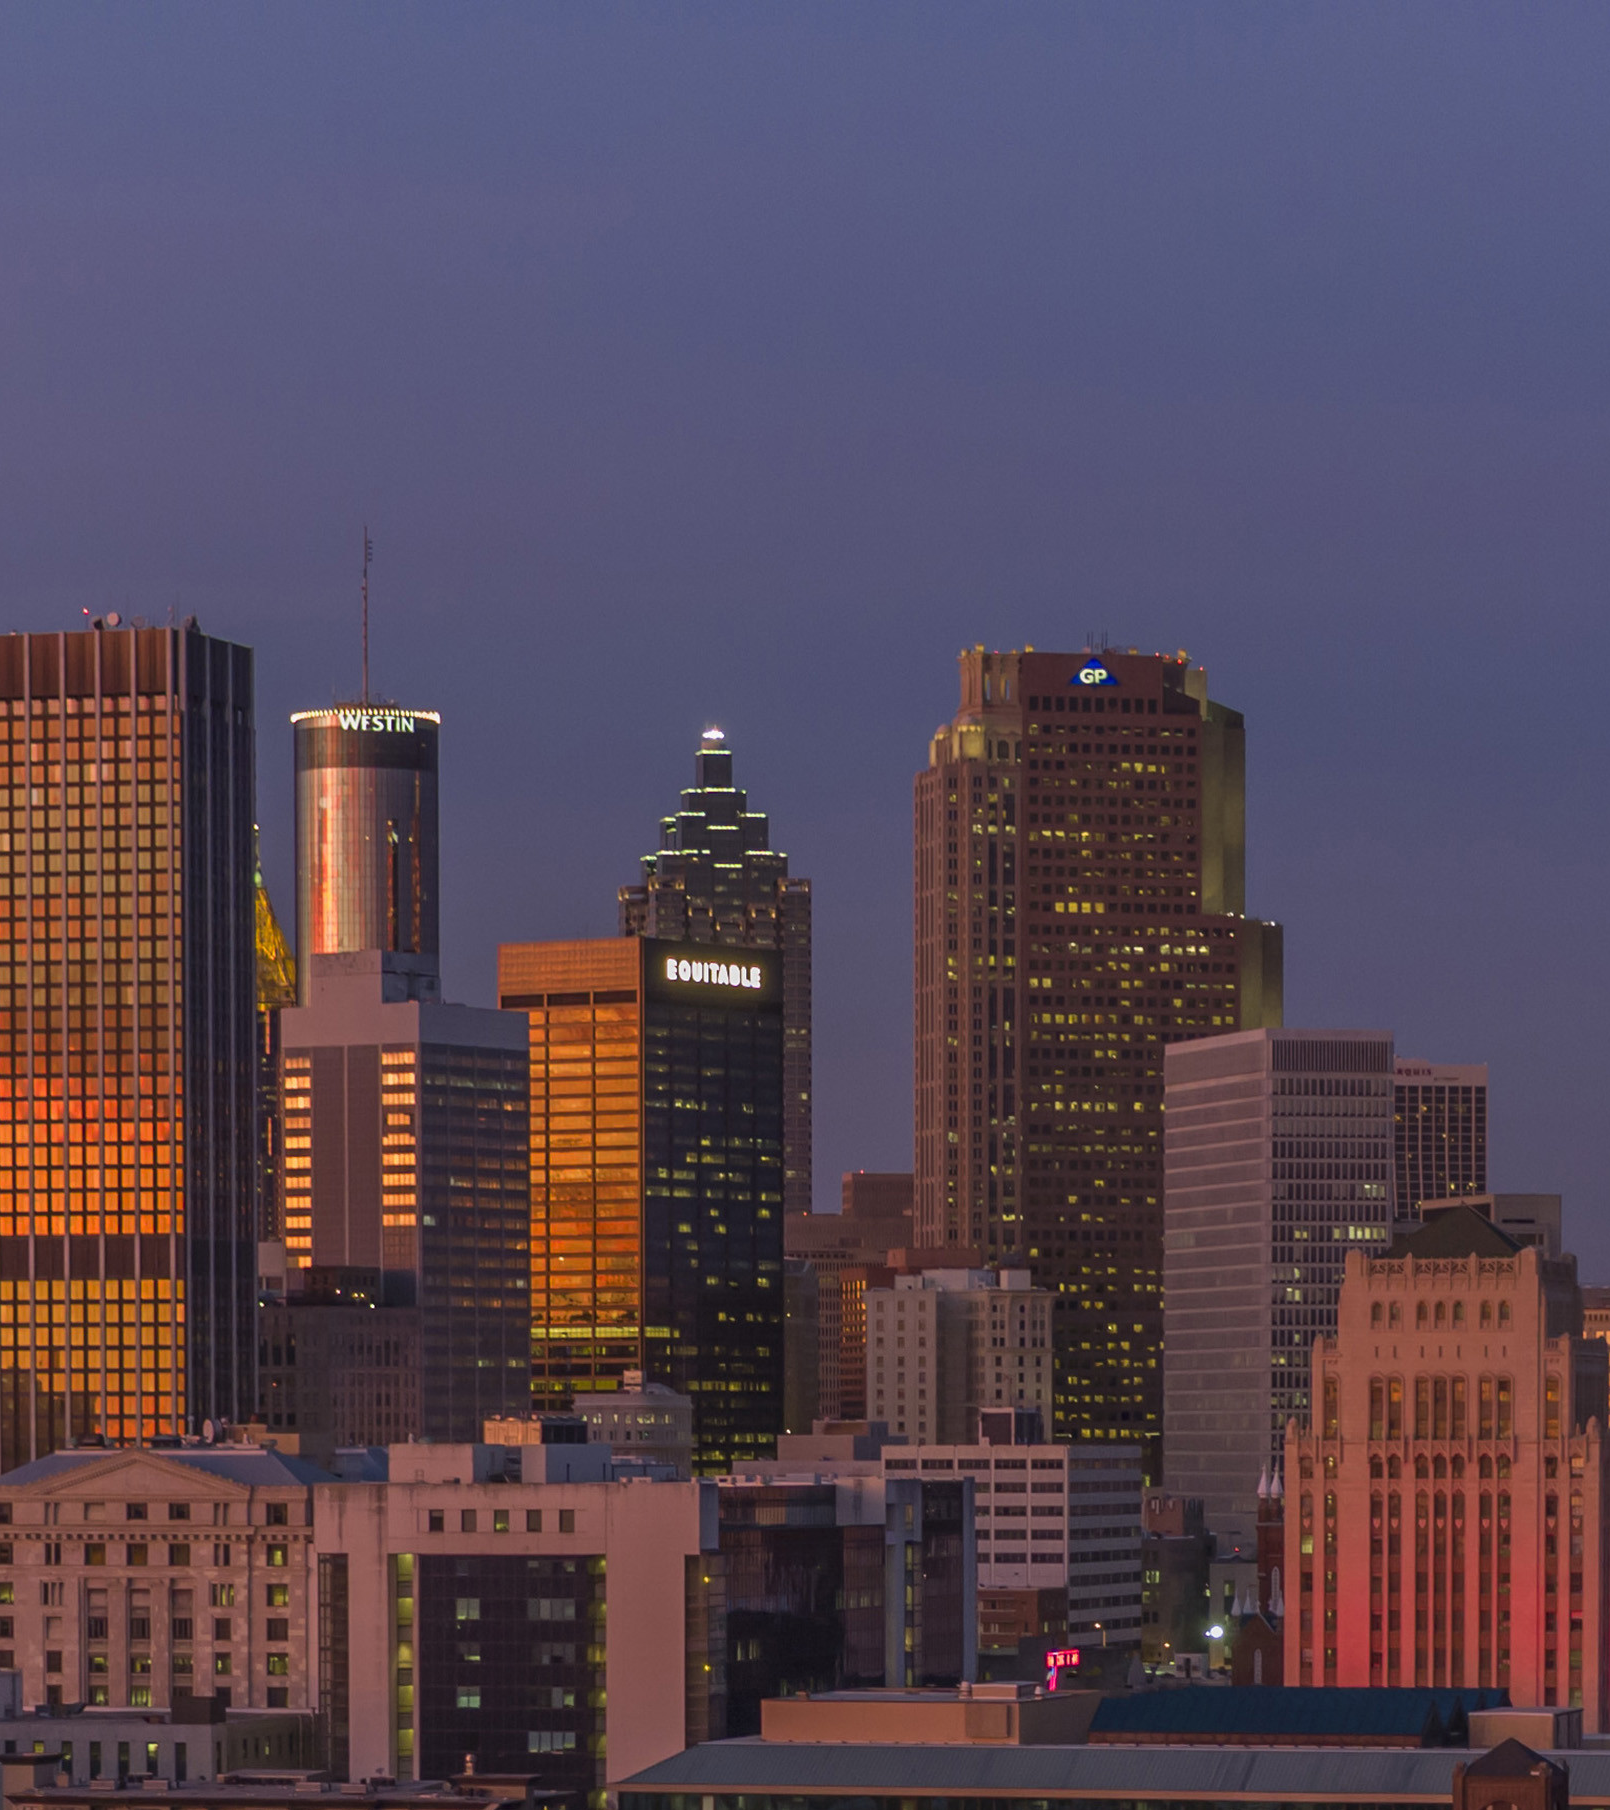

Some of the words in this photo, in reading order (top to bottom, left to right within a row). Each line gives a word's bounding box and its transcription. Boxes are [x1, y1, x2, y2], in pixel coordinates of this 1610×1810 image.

[1079, 668, 1108, 684] GP
[338, 712, 415, 733] WESTIN
[666, 958, 761, 989] EQUITABLE
